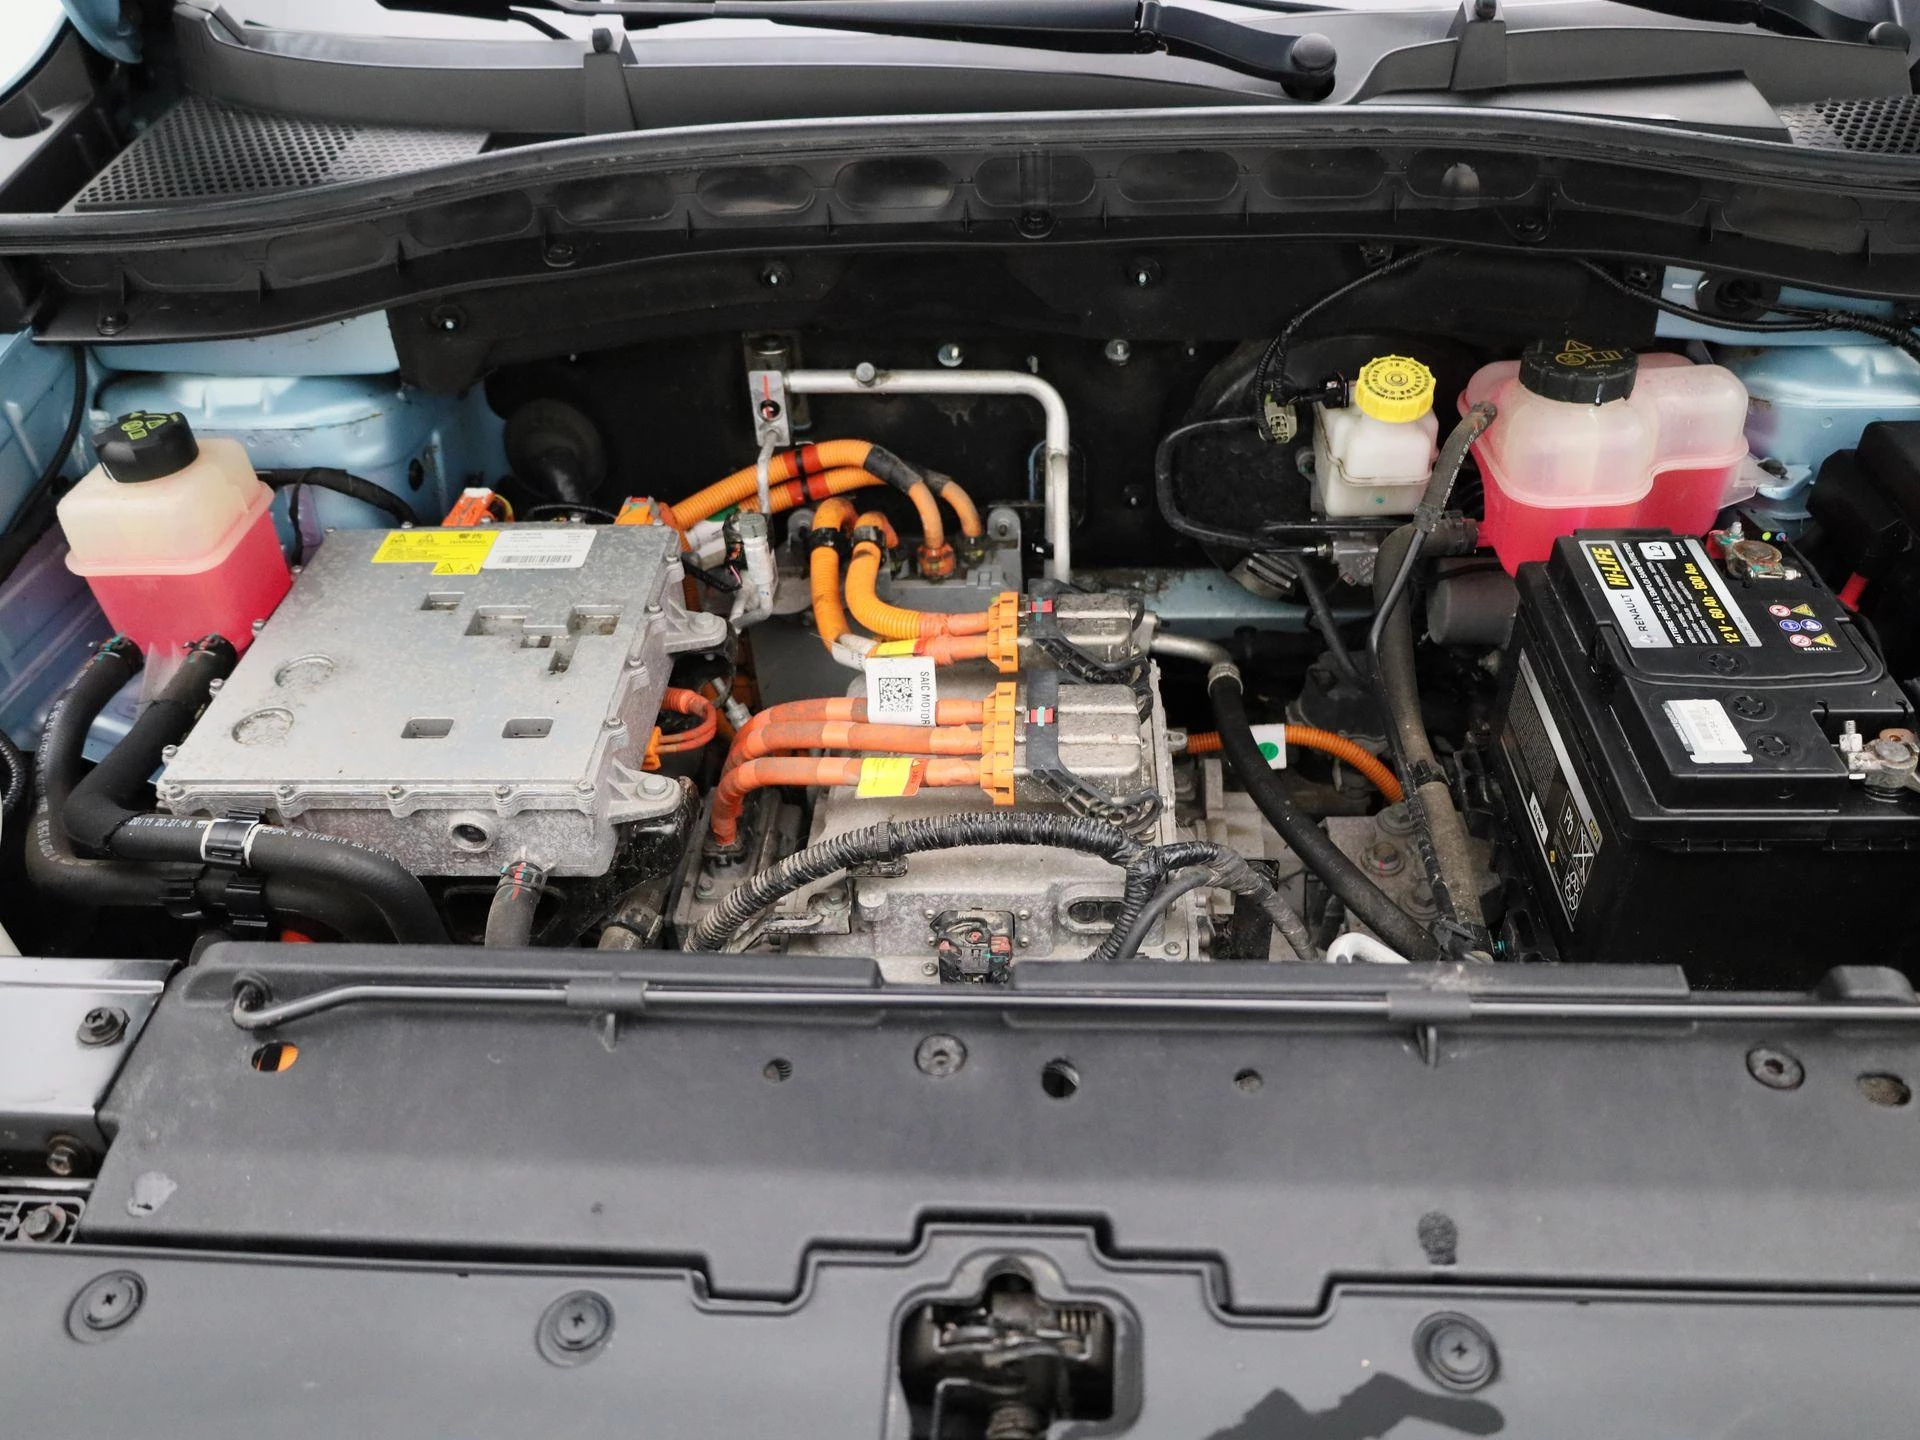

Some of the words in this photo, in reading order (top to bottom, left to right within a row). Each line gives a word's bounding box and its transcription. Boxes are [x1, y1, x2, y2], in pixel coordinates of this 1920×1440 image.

[1649, 545, 1666, 557] L2
[1591, 547, 1629, 587] Hi-LIFE
[1688, 575, 1708, 590] 600
[1621, 594, 1648, 632] RENAULT
[1708, 608, 1725, 619] 60
[1724, 632, 1741, 644] 12
[920, 671, 930, 691] SAIC
[921, 694, 931, 727] MOTOR
[1564, 806, 1574, 836] Pb
